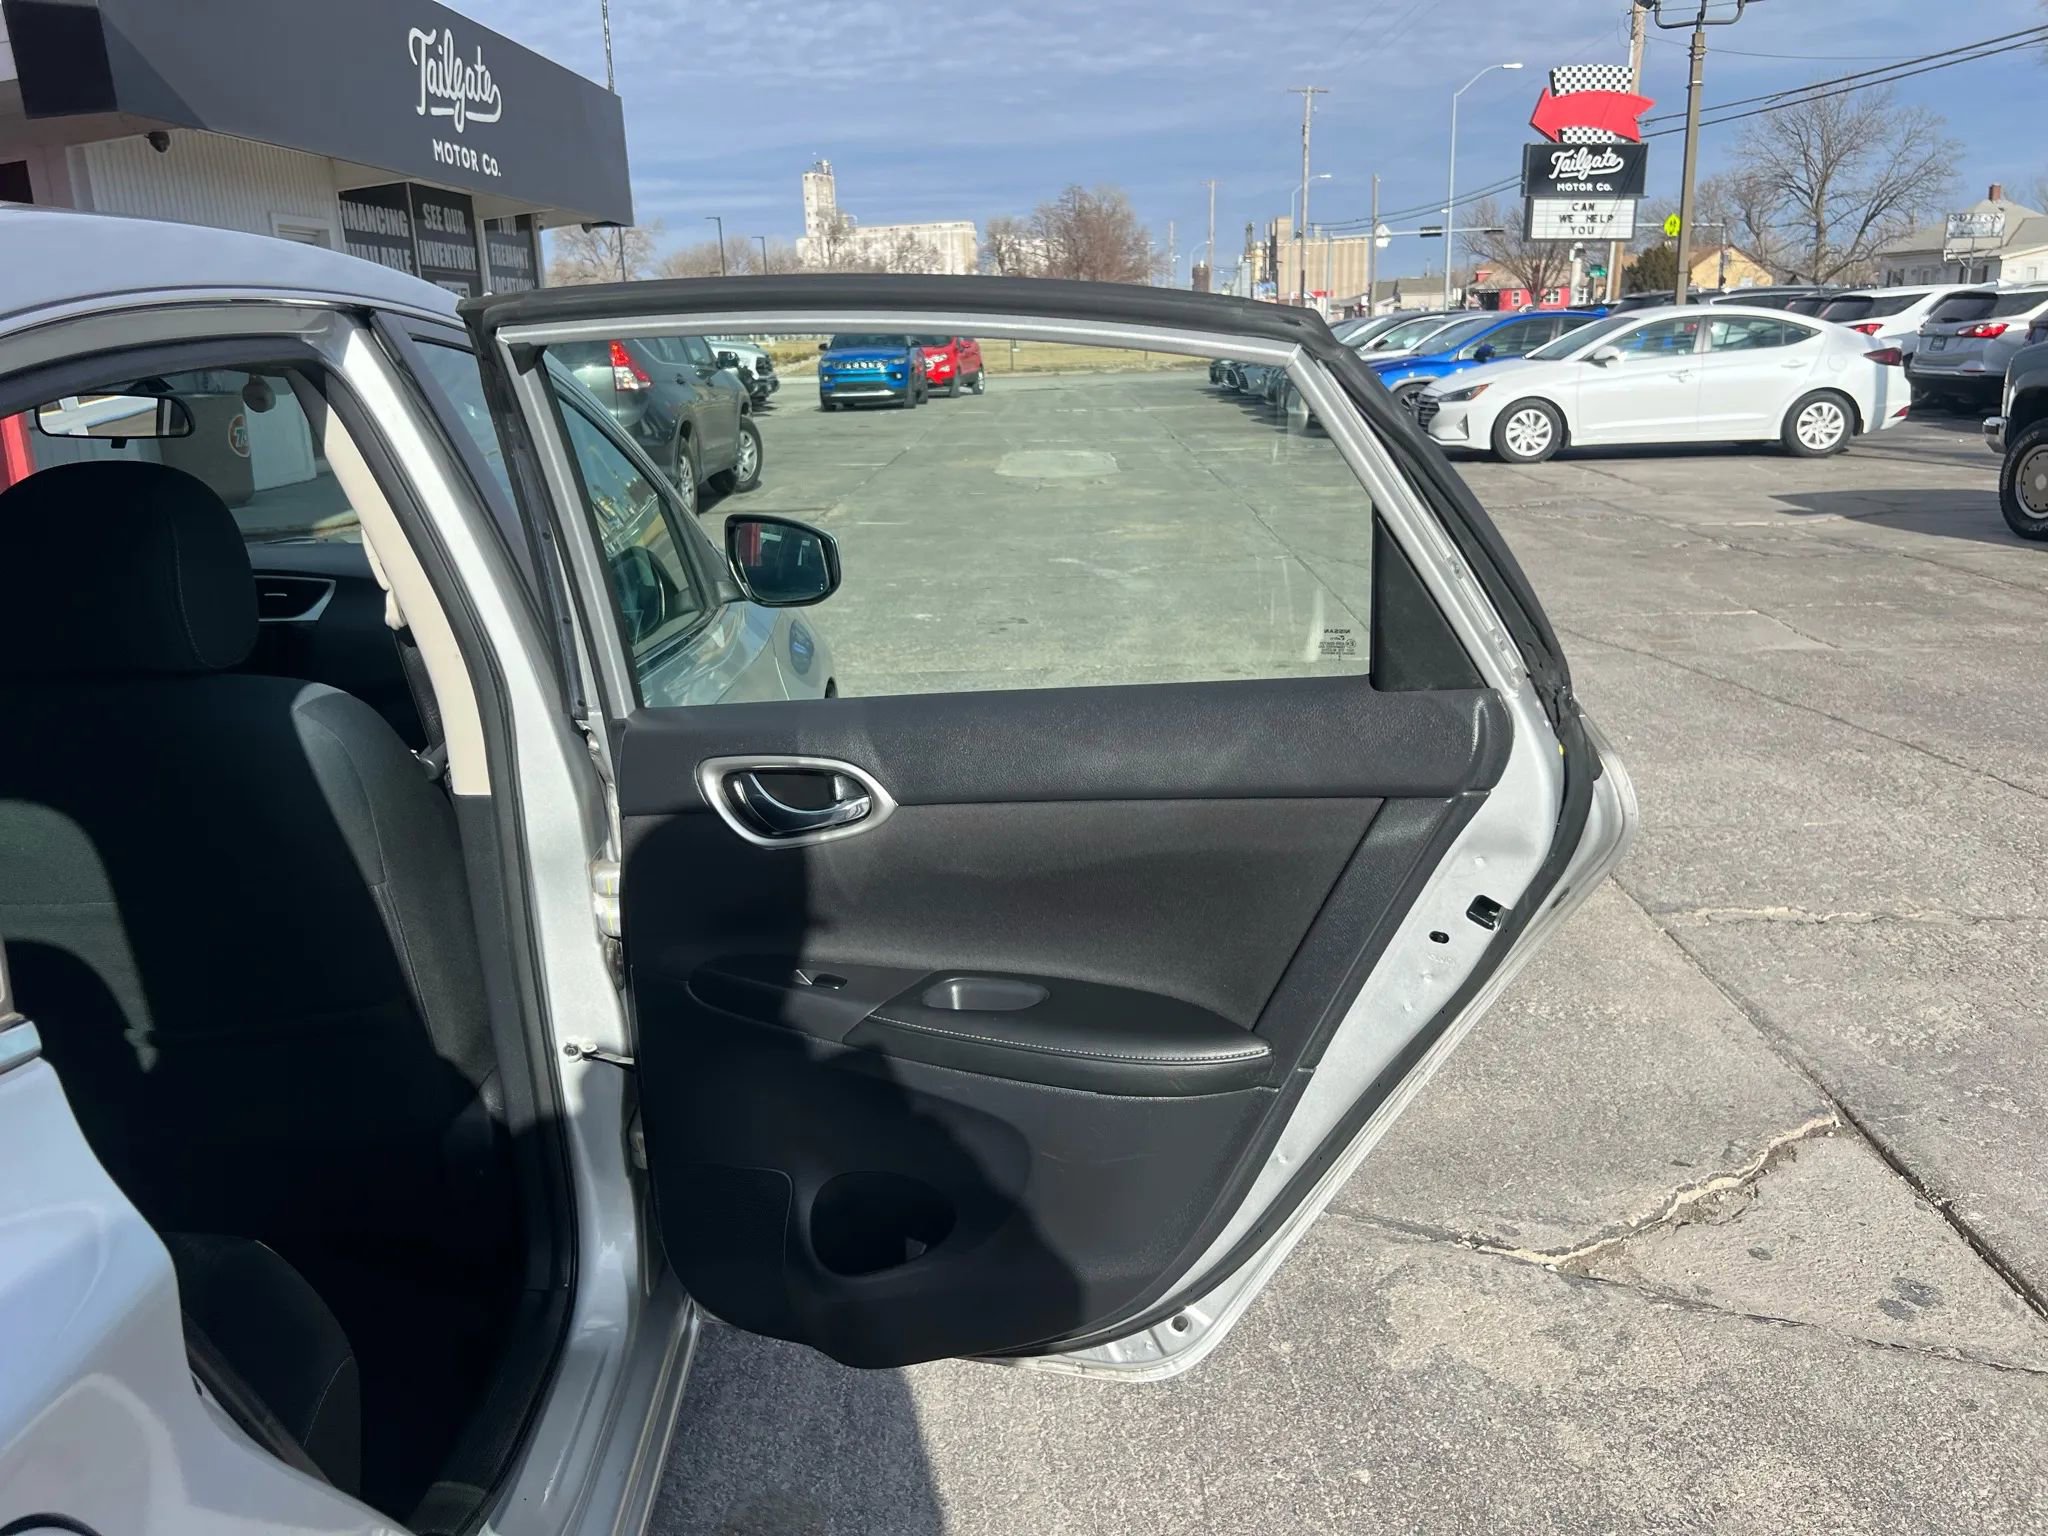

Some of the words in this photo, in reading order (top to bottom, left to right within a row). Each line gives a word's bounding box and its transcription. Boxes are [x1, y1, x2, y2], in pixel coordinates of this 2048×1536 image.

[408, 27, 502, 133] Tailgate
[432, 138, 480, 172] MOTOR
[482, 153, 502, 177] CO.
[1548, 146, 1624, 181] Tailgate
[1557, 182, 1593, 191] MOTOR
[342, 200, 409, 238] INANCING
[422, 203, 445, 232] SEE
[443, 207, 467, 235] OUR
[1559, 214, 1574, 223] WE
[1586, 214, 1614, 223] HELP
[1572, 202, 1595, 212] CAN
[1570, 226, 1595, 235] YOU
[418, 240, 477, 271] INVENTORY
